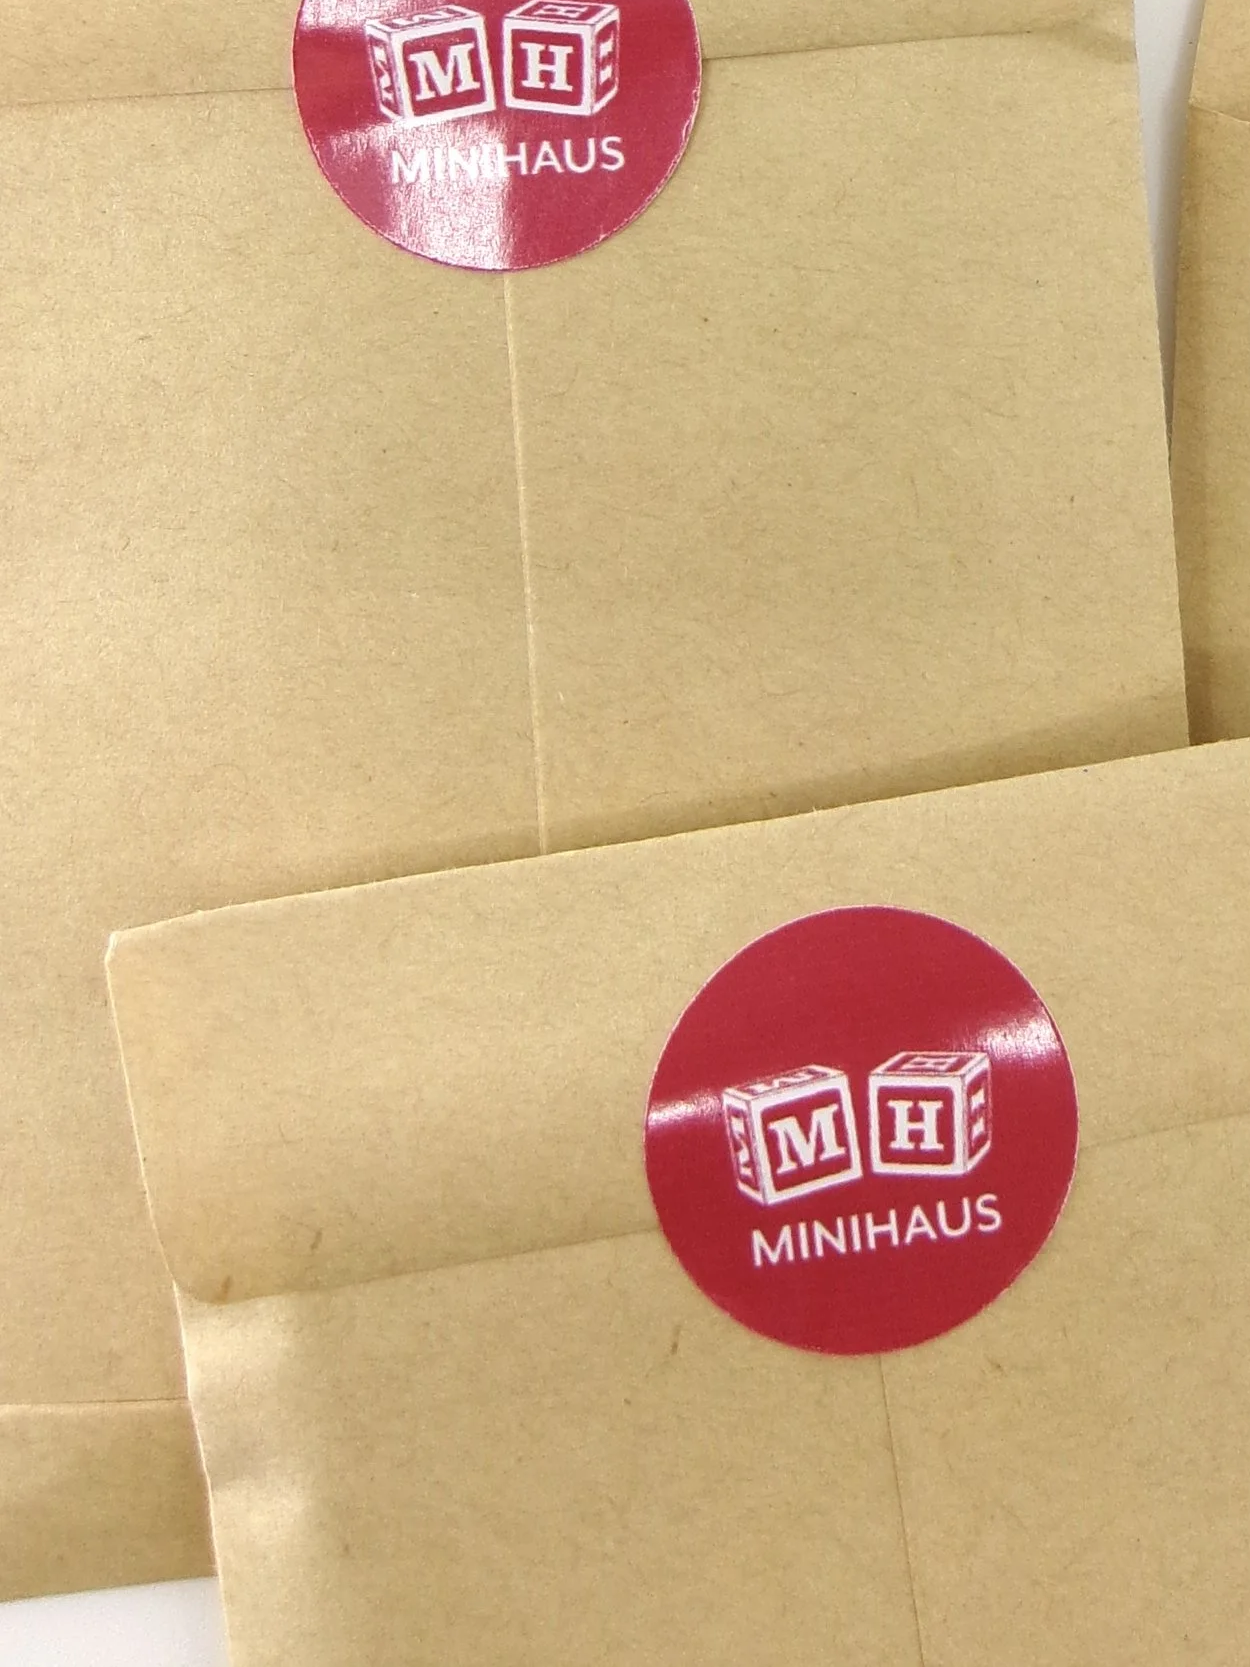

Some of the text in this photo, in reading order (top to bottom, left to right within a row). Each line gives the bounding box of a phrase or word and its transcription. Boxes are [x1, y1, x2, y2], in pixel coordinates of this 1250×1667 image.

[408, 42, 481, 101] M
[520, 42, 573, 92] H
[391, 136, 626, 185] MINIHAUS
[768, 1103, 846, 1175] M
[887, 1100, 944, 1150] H
[751, 1193, 1003, 1267] MINIHAUS
